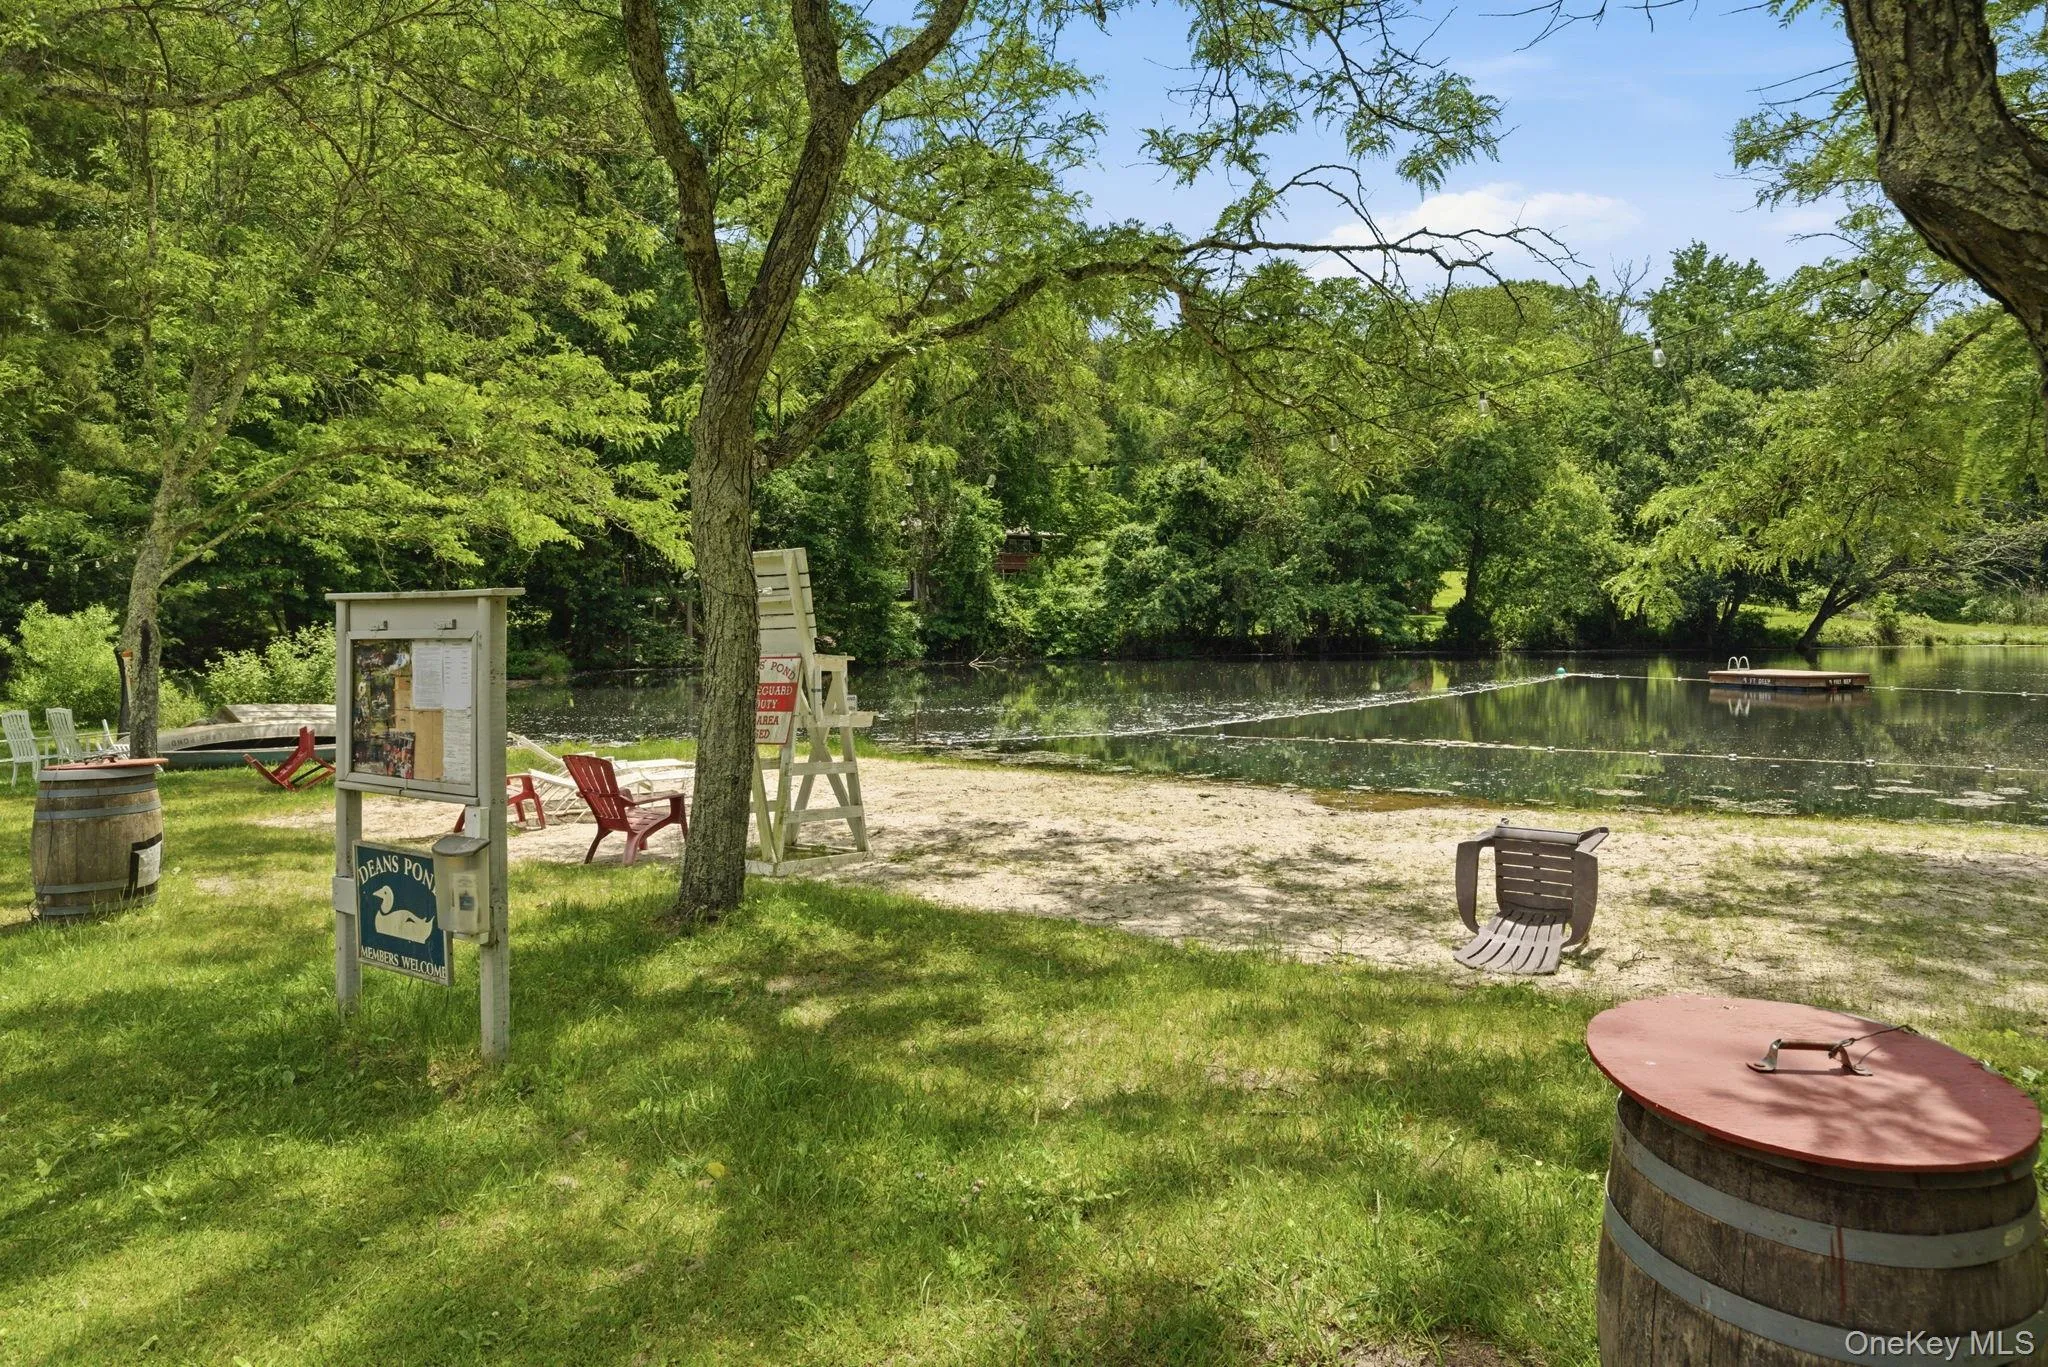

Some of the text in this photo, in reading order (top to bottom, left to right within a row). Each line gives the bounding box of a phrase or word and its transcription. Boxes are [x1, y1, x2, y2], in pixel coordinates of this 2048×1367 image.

[770, 661, 797, 681] POND
[757, 685, 793, 696] EGUARD
[756, 715, 779, 726] AREA
[358, 855, 399, 885] DEANS
[403, 857, 437, 896] PON
[360, 944, 447, 978] MEMBERS WELCOME
